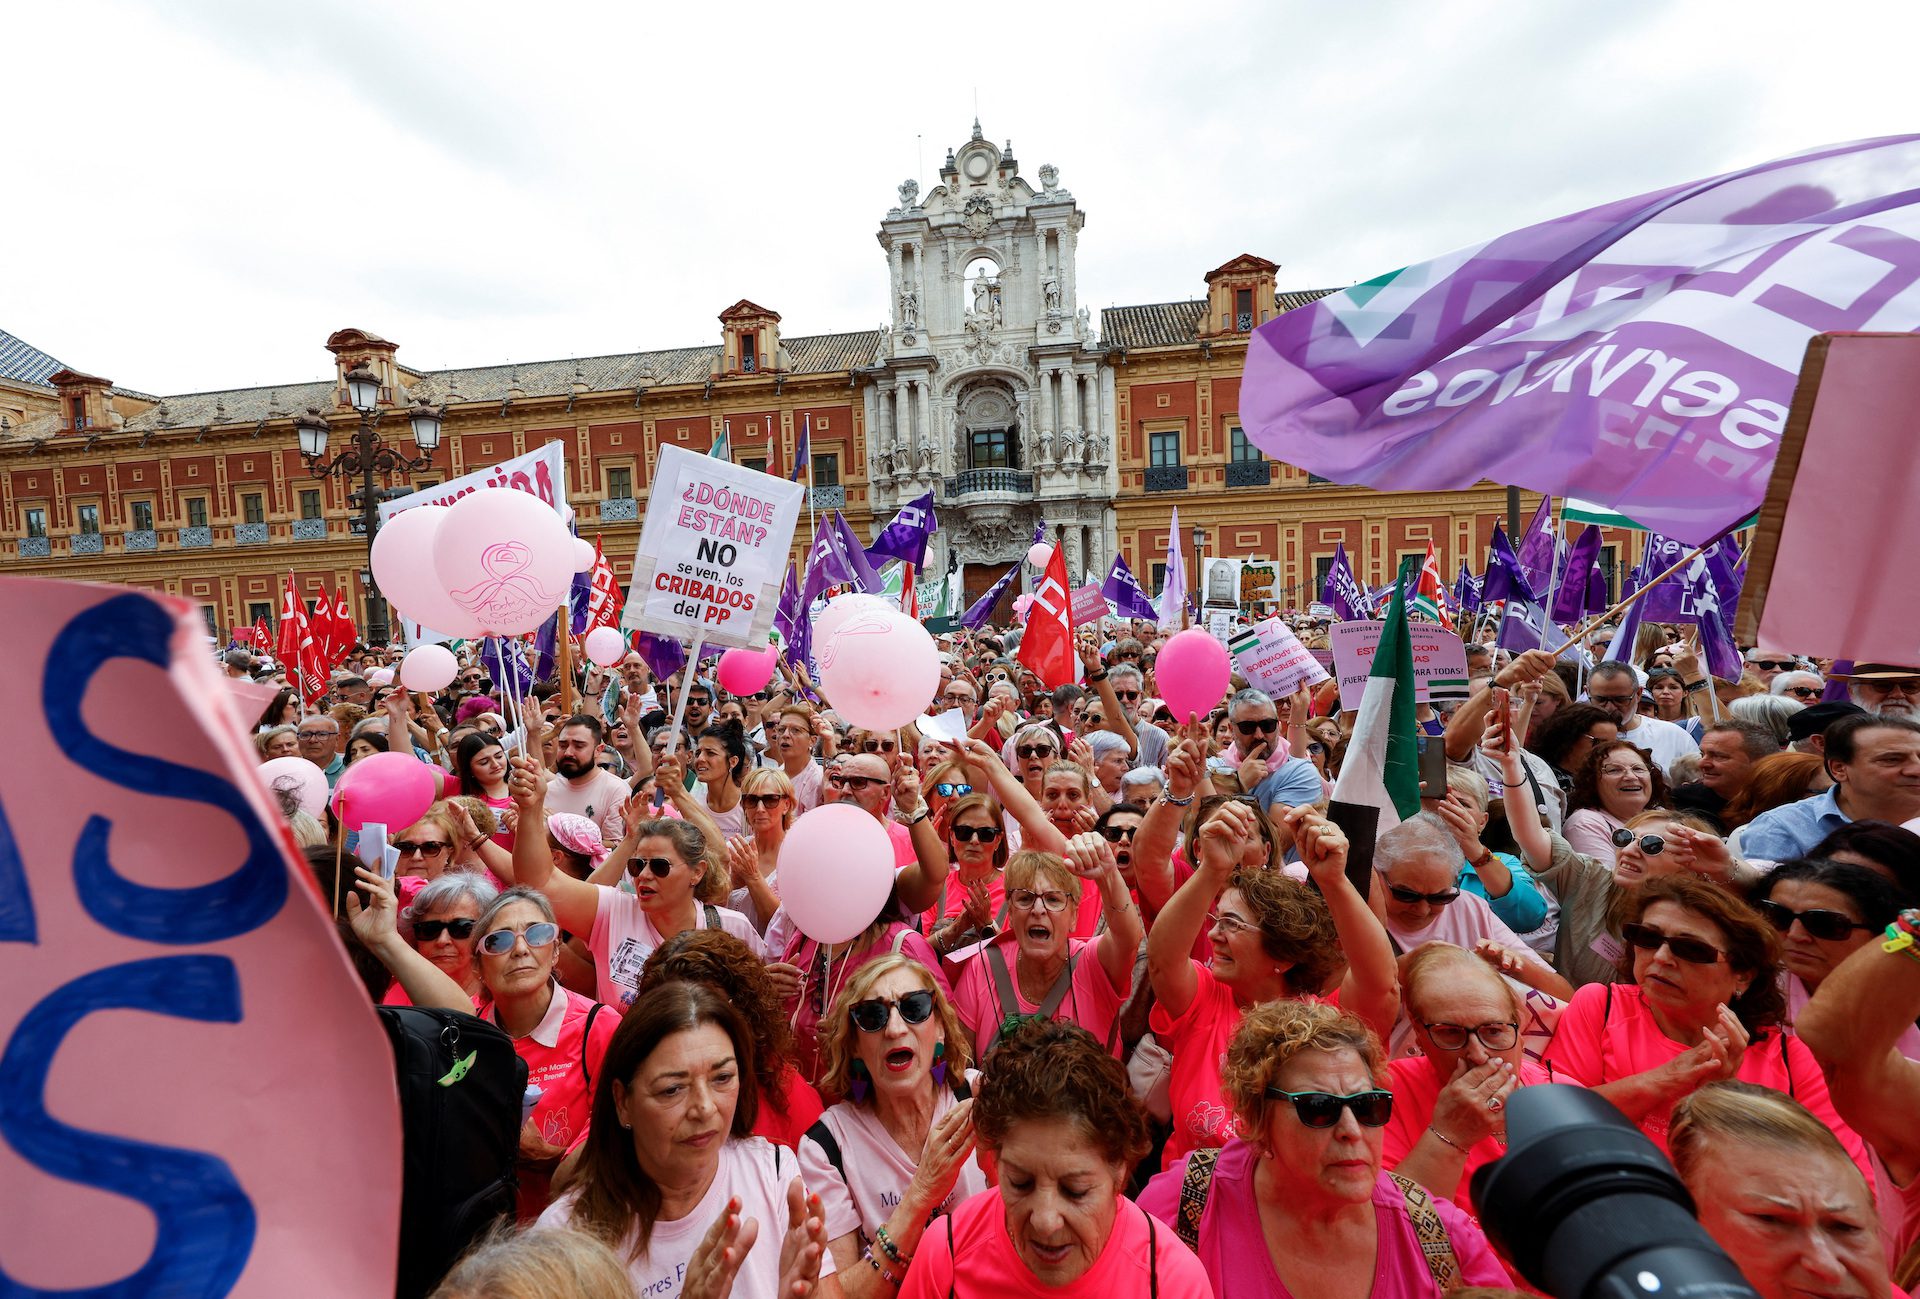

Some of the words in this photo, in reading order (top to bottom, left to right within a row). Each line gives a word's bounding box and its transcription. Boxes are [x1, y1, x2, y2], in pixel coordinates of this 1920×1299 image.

[682, 482, 776, 525] ¿DÓNDE
[677, 504, 768, 547] ESTÁN?
[696, 537, 737, 568] NO
[677, 562, 693, 574] se
[695, 567, 722, 584] ven,
[725, 573, 744, 587] los
[655, 572, 756, 611] CRIBADOS
[673, 600, 701, 619] del
[704, 605, 731, 625] PP
[1246, 647, 1291, 673] APOYAMOS
[1272, 654, 1307, 673] MUJERES
[1434, 667, 1464, 675] TODAS!
[1260, 669, 1273, 679] DE
[0, 591, 290, 945] S
